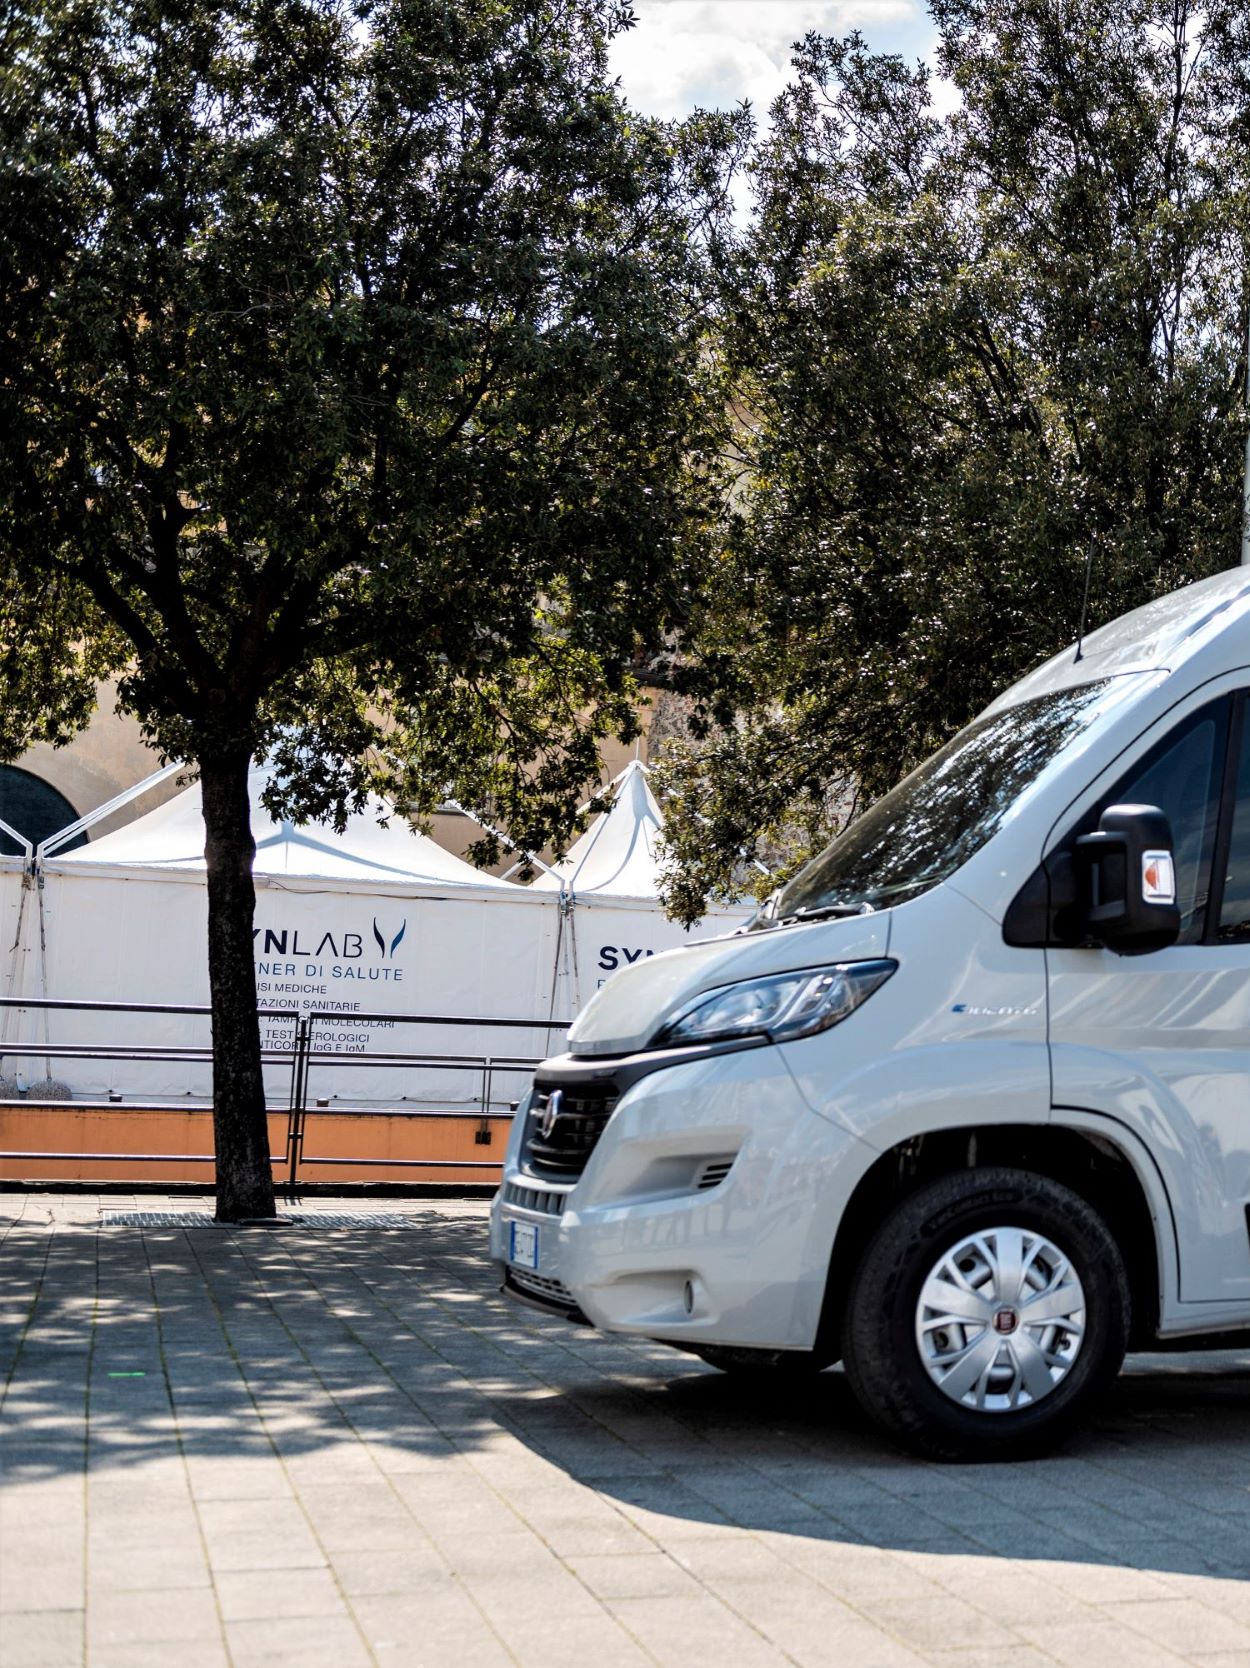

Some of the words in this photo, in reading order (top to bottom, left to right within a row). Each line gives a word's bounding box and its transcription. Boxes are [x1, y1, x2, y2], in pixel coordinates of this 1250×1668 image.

[256, 962, 296, 976] NER
[306, 965, 323, 977] DI
[332, 966, 403, 981] SALUTE
[257, 982, 271, 991] ISI
[275, 983, 327, 994] MEDICHE
[257, 998, 299, 1009] TAZIONI
[303, 1000, 361, 1012] SANITARIE
[321, 1017, 395, 1028] MOLECOLARI
[266, 1029, 294, 1039] TEST
